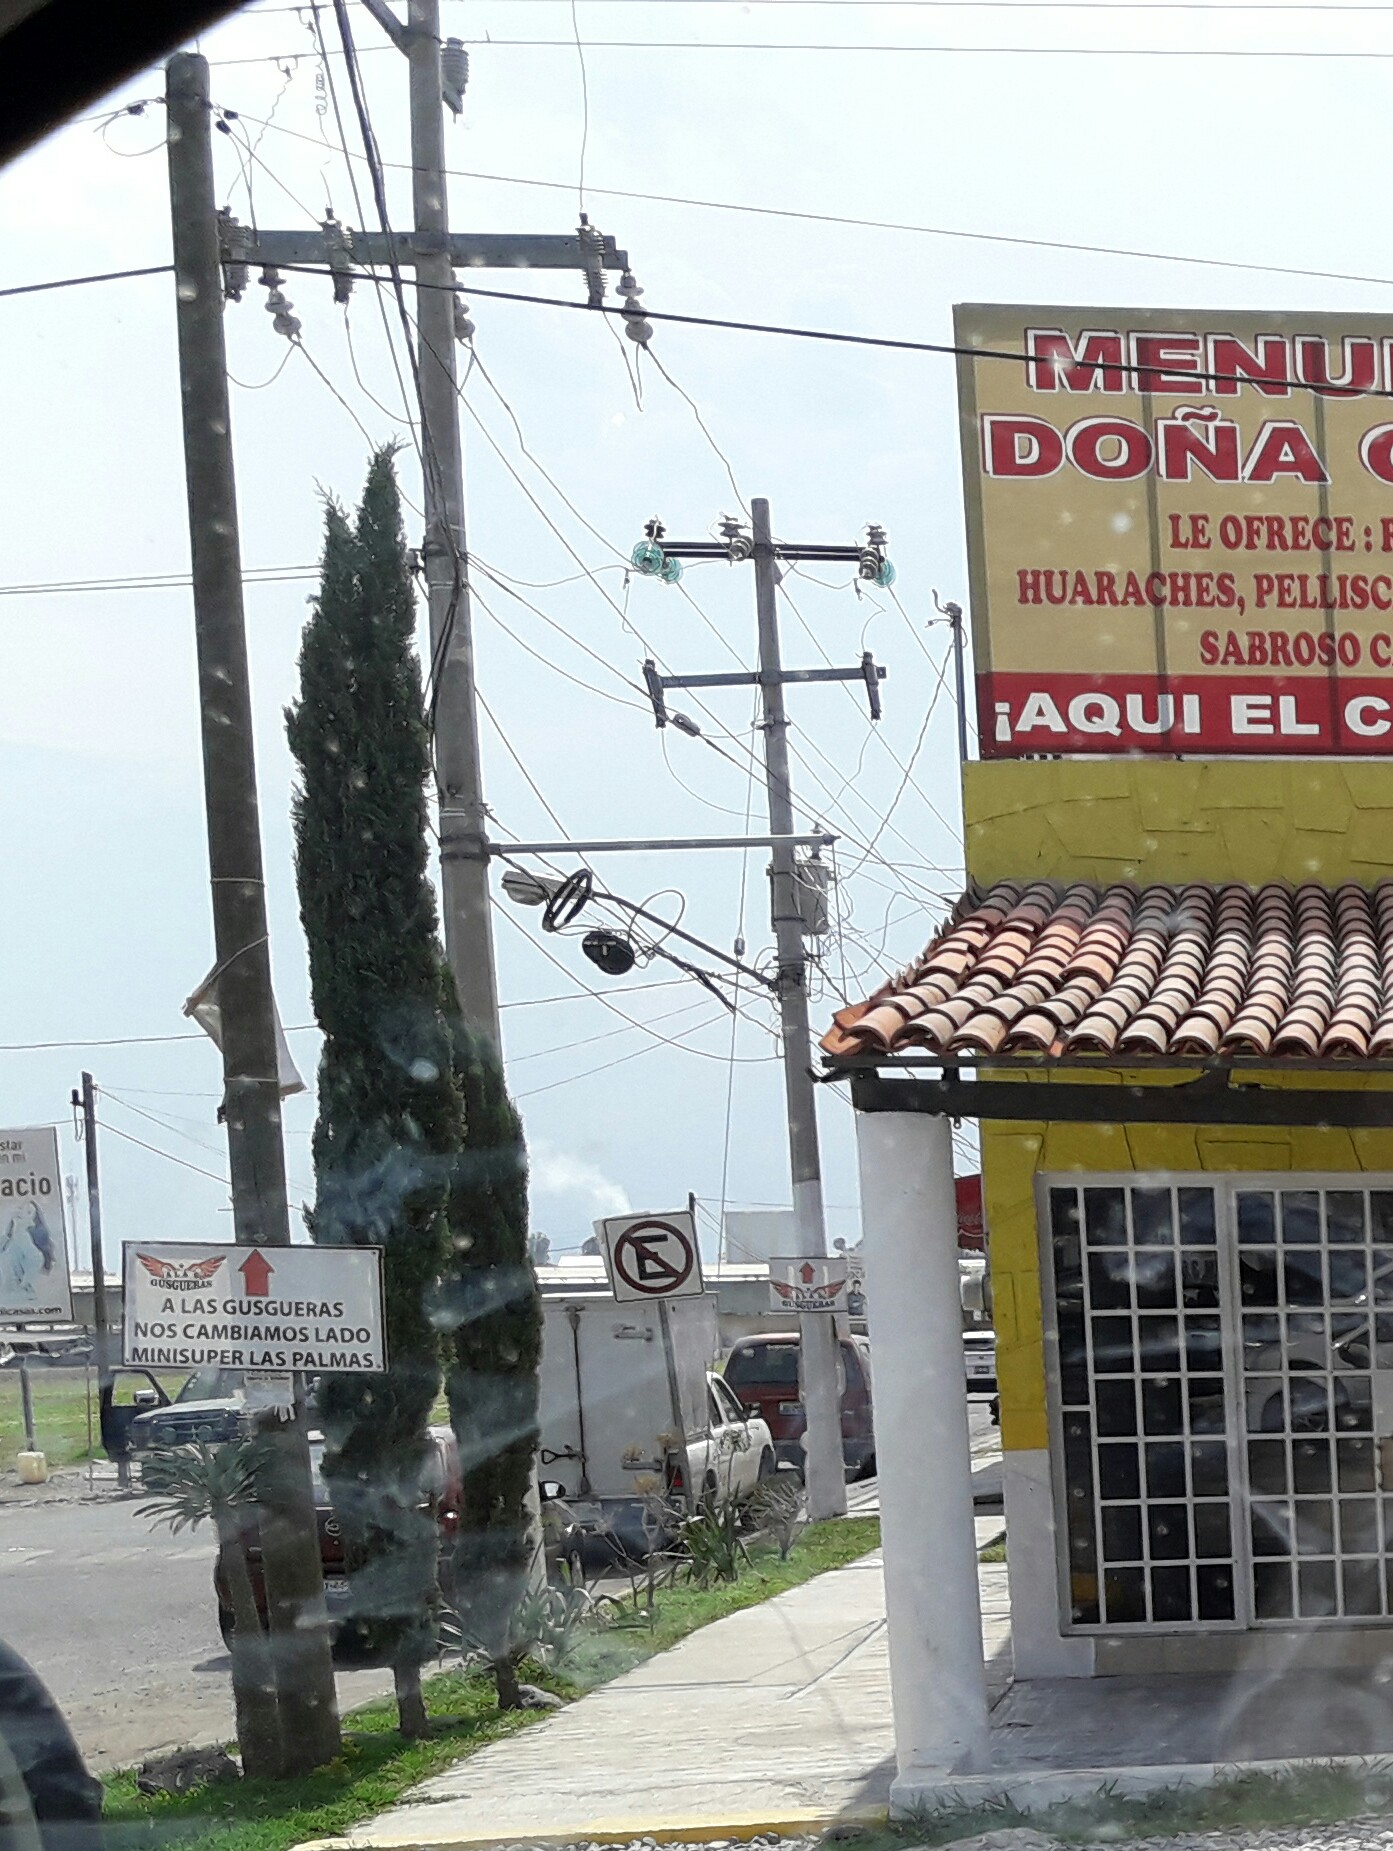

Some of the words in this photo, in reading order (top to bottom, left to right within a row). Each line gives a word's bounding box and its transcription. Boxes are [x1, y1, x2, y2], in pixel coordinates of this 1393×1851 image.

[981, 404, 1332, 486] DOÑA
[1168, 513, 1211, 550] LE
[1219, 514, 1356, 552] OFRECE
[1017, 569, 1246, 616] HUARACHES,
[1200, 629, 1362, 667] SABROSO
[1230, 695, 1320, 735] EL
[161, 1298, 176, 1314] A
[180, 1298, 218, 1315] LAS
[222, 1299, 344, 1319] GUSGUERAS
[134, 1322, 178, 1339] NOS
[182, 1323, 310, 1343] CAMBIAMOS
[314, 1327, 371, 1344] LADO
[131, 1347, 244, 1366] MINISUPER
[249, 1350, 287, 1368] LAS
[292, 1351, 374, 1369] PALMAS
